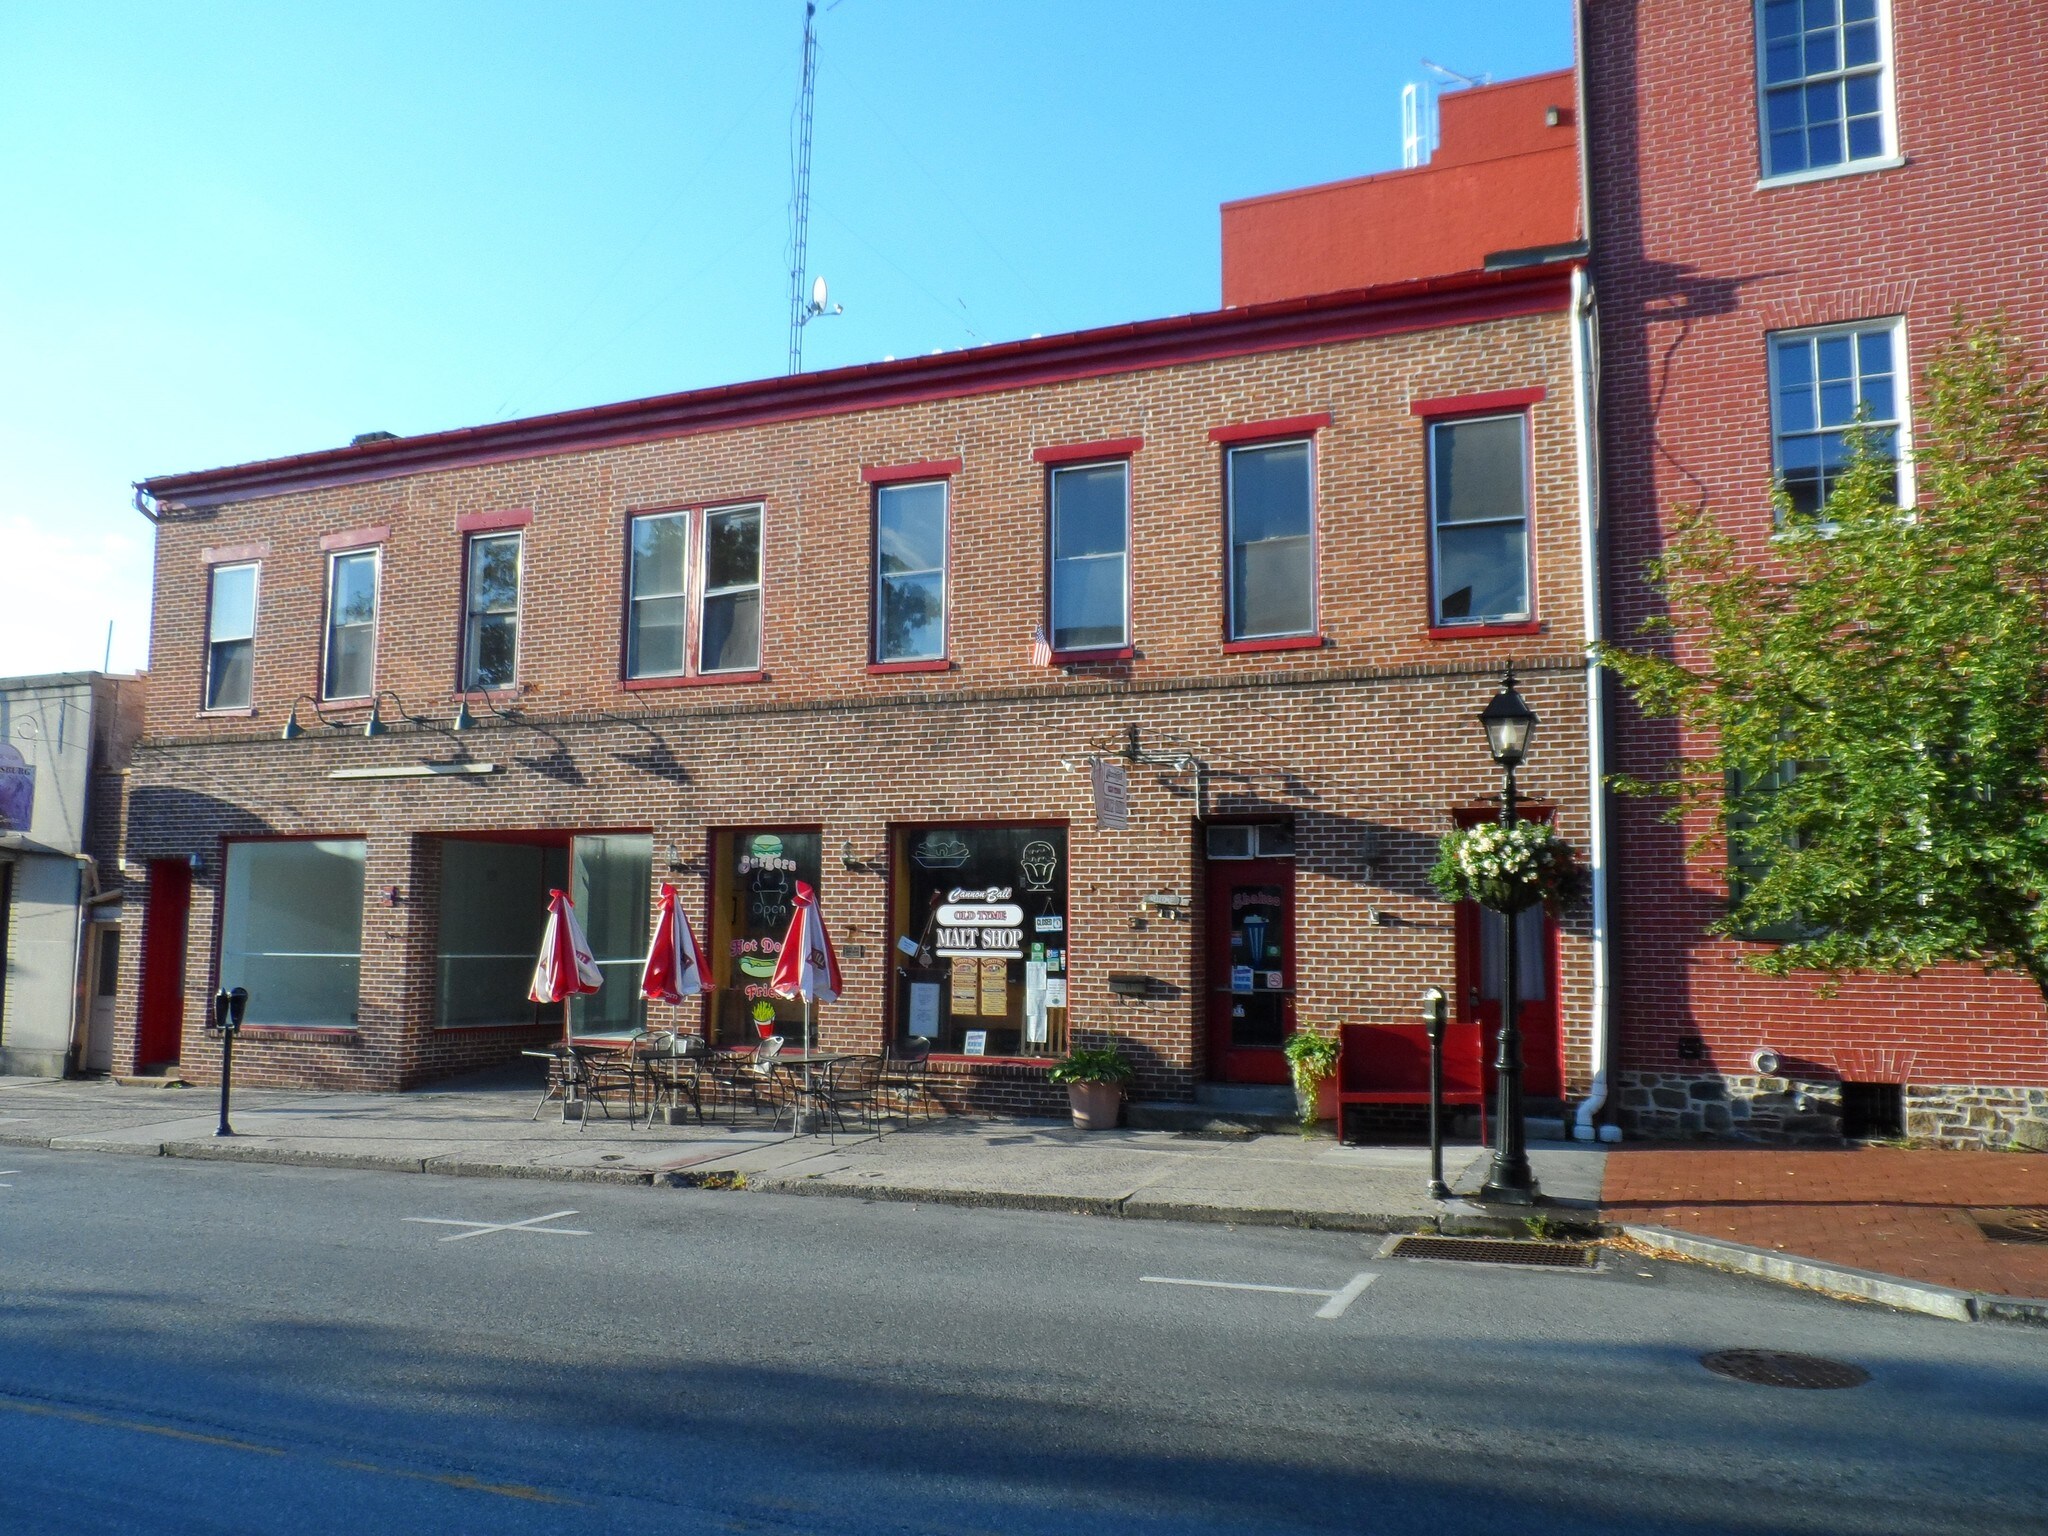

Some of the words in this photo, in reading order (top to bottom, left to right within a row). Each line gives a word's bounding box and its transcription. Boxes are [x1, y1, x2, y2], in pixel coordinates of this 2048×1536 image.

[738, 855, 797, 874] Burgers
[948, 887, 986, 903] Cannon
[985, 886, 1012, 903] Ball
[752, 902, 787, 918] Open
[954, 910, 976, 921] OLD
[977, 910, 1007, 921] TYME
[730, 938, 758, 957] Hot
[761, 937, 783, 954] Do
[936, 928, 979, 949] MALT
[982, 928, 1022, 949] SHOP
